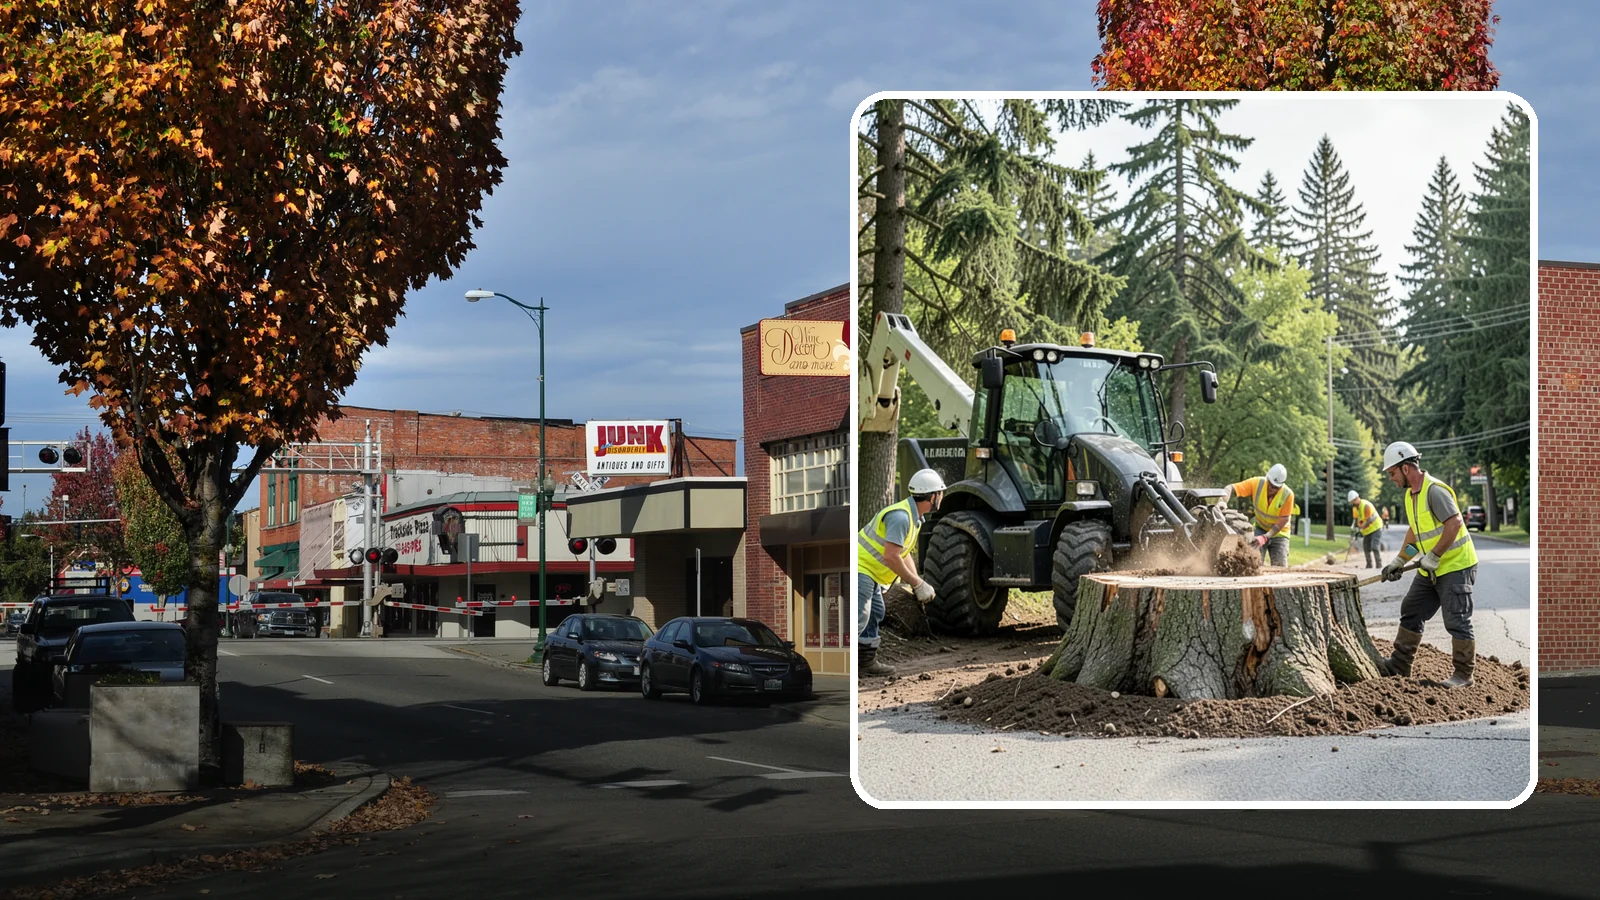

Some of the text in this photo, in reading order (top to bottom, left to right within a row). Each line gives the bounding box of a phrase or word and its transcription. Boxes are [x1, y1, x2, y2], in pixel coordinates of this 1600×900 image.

[595, 425, 665, 457] JUNK
[607, 446, 646, 454] DISORDERLY
[596, 460, 666, 470] ANTIQUES AND GIFTS
[414, 519, 429, 535] Pizza
